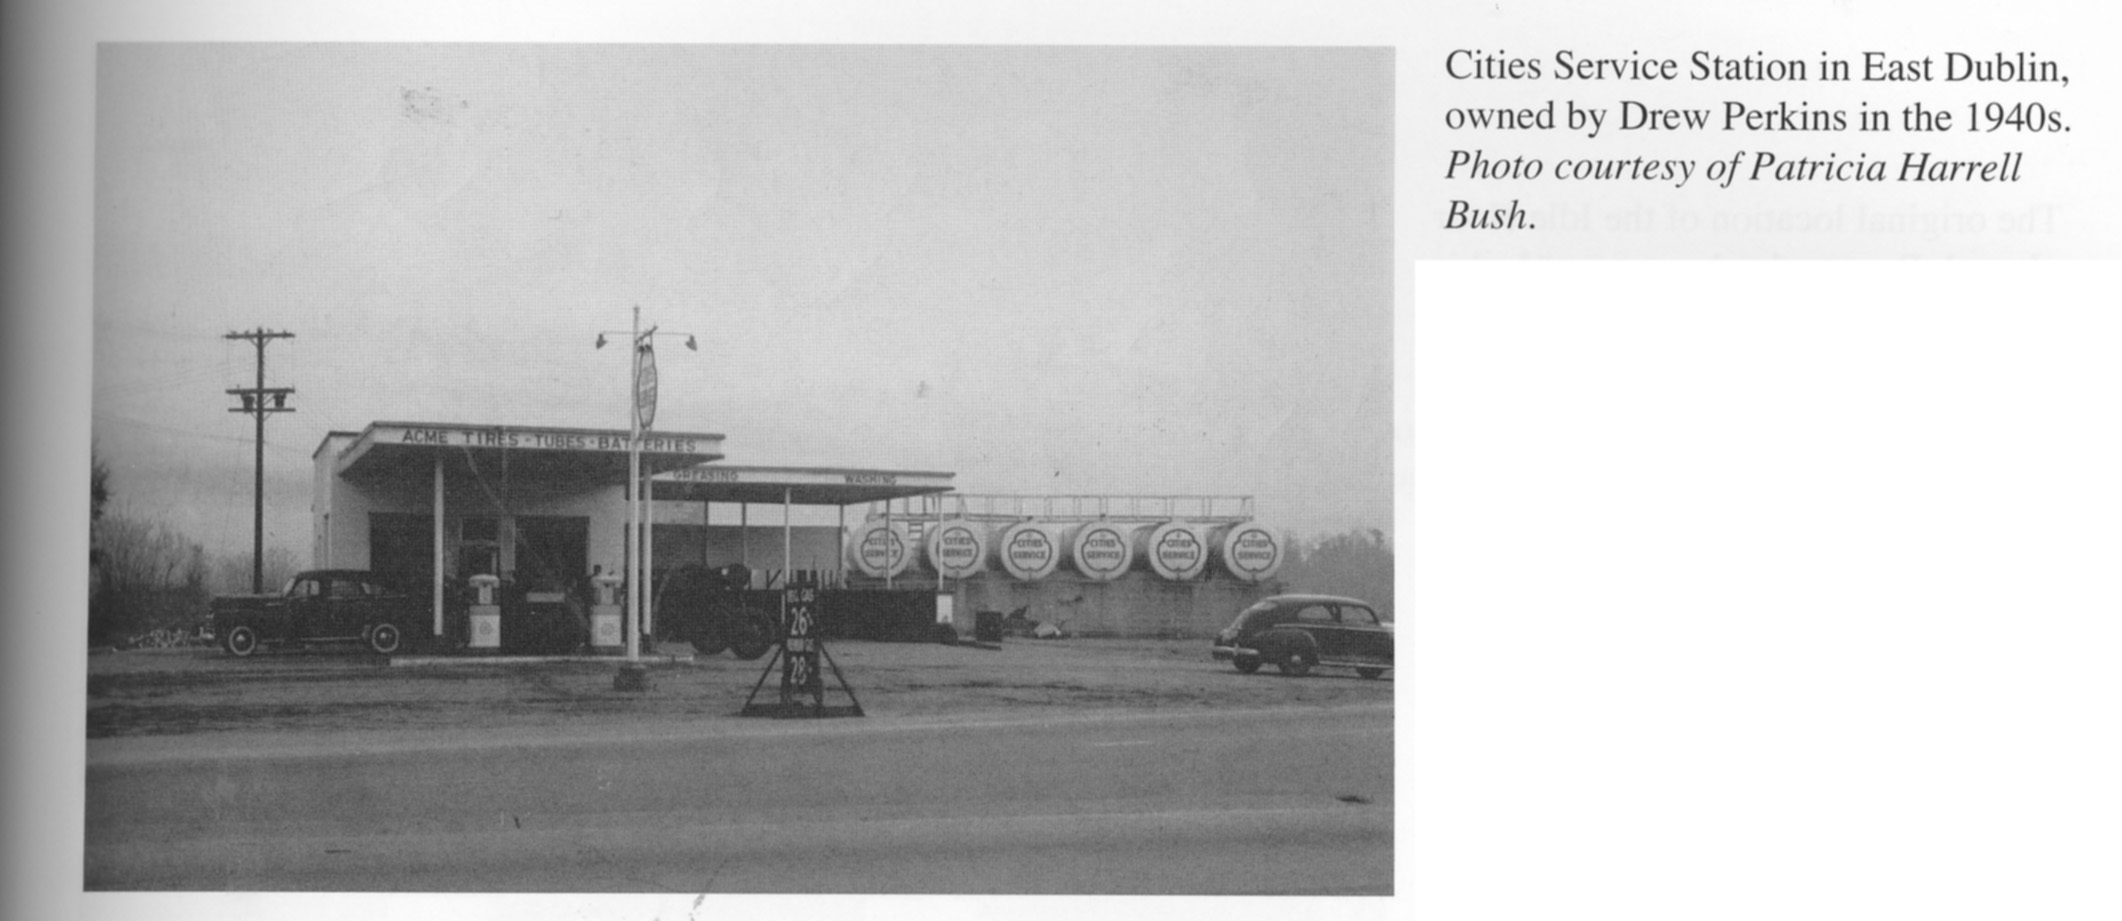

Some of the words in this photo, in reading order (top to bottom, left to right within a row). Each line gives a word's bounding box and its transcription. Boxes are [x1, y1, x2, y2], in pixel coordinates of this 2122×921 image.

[402, 430, 449, 444] ACME
[462, 431, 519, 447] TIRES
[535, 434, 586, 449] TUBES
[599, 437, 697, 453] BATERIES
[673, 469, 738, 482] GREASING
[844, 471, 897, 485] WASHING
[1017, 538, 1044, 548] CITIES
[1089, 538, 1116, 548] CITIES
[1166, 538, 1193, 548] CITIES
[1241, 538, 1268, 548] CITIES
[1013, 550, 1046, 560] SERVICE
[1086, 550, 1120, 560] SERVICE
[1162, 550, 1195, 560] SERVICE
[1237, 550, 1271, 560] SERVICE
[790, 606, 808, 636] 26
[790, 655, 807, 685] 28
